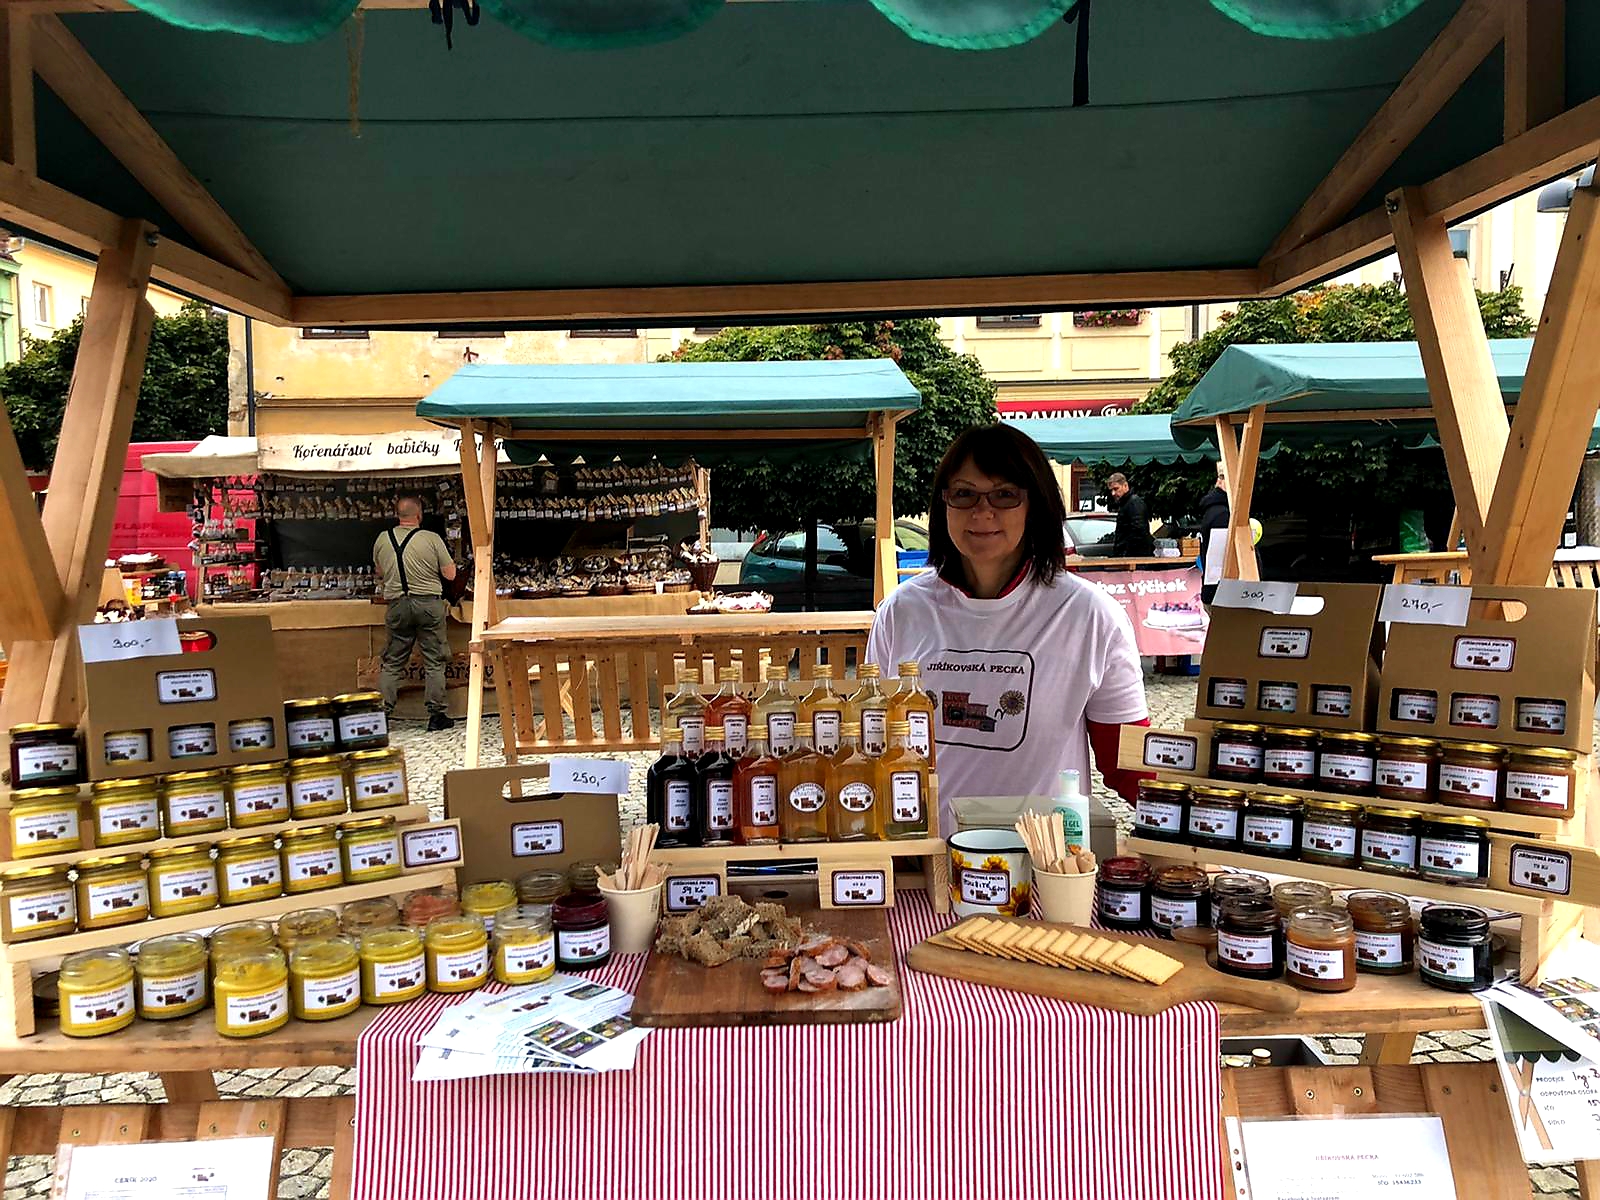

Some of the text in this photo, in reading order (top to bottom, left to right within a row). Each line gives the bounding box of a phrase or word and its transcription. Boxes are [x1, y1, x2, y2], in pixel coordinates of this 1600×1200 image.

[292, 441, 373, 461] Kořenářství
[386, 440, 440, 457] babičky
[1128, 578, 1187, 596] výčitek
[927, 661, 1025, 675] JIŘÍKOVSKÁ PECKA
[572, 771, 607, 787] 250,-
